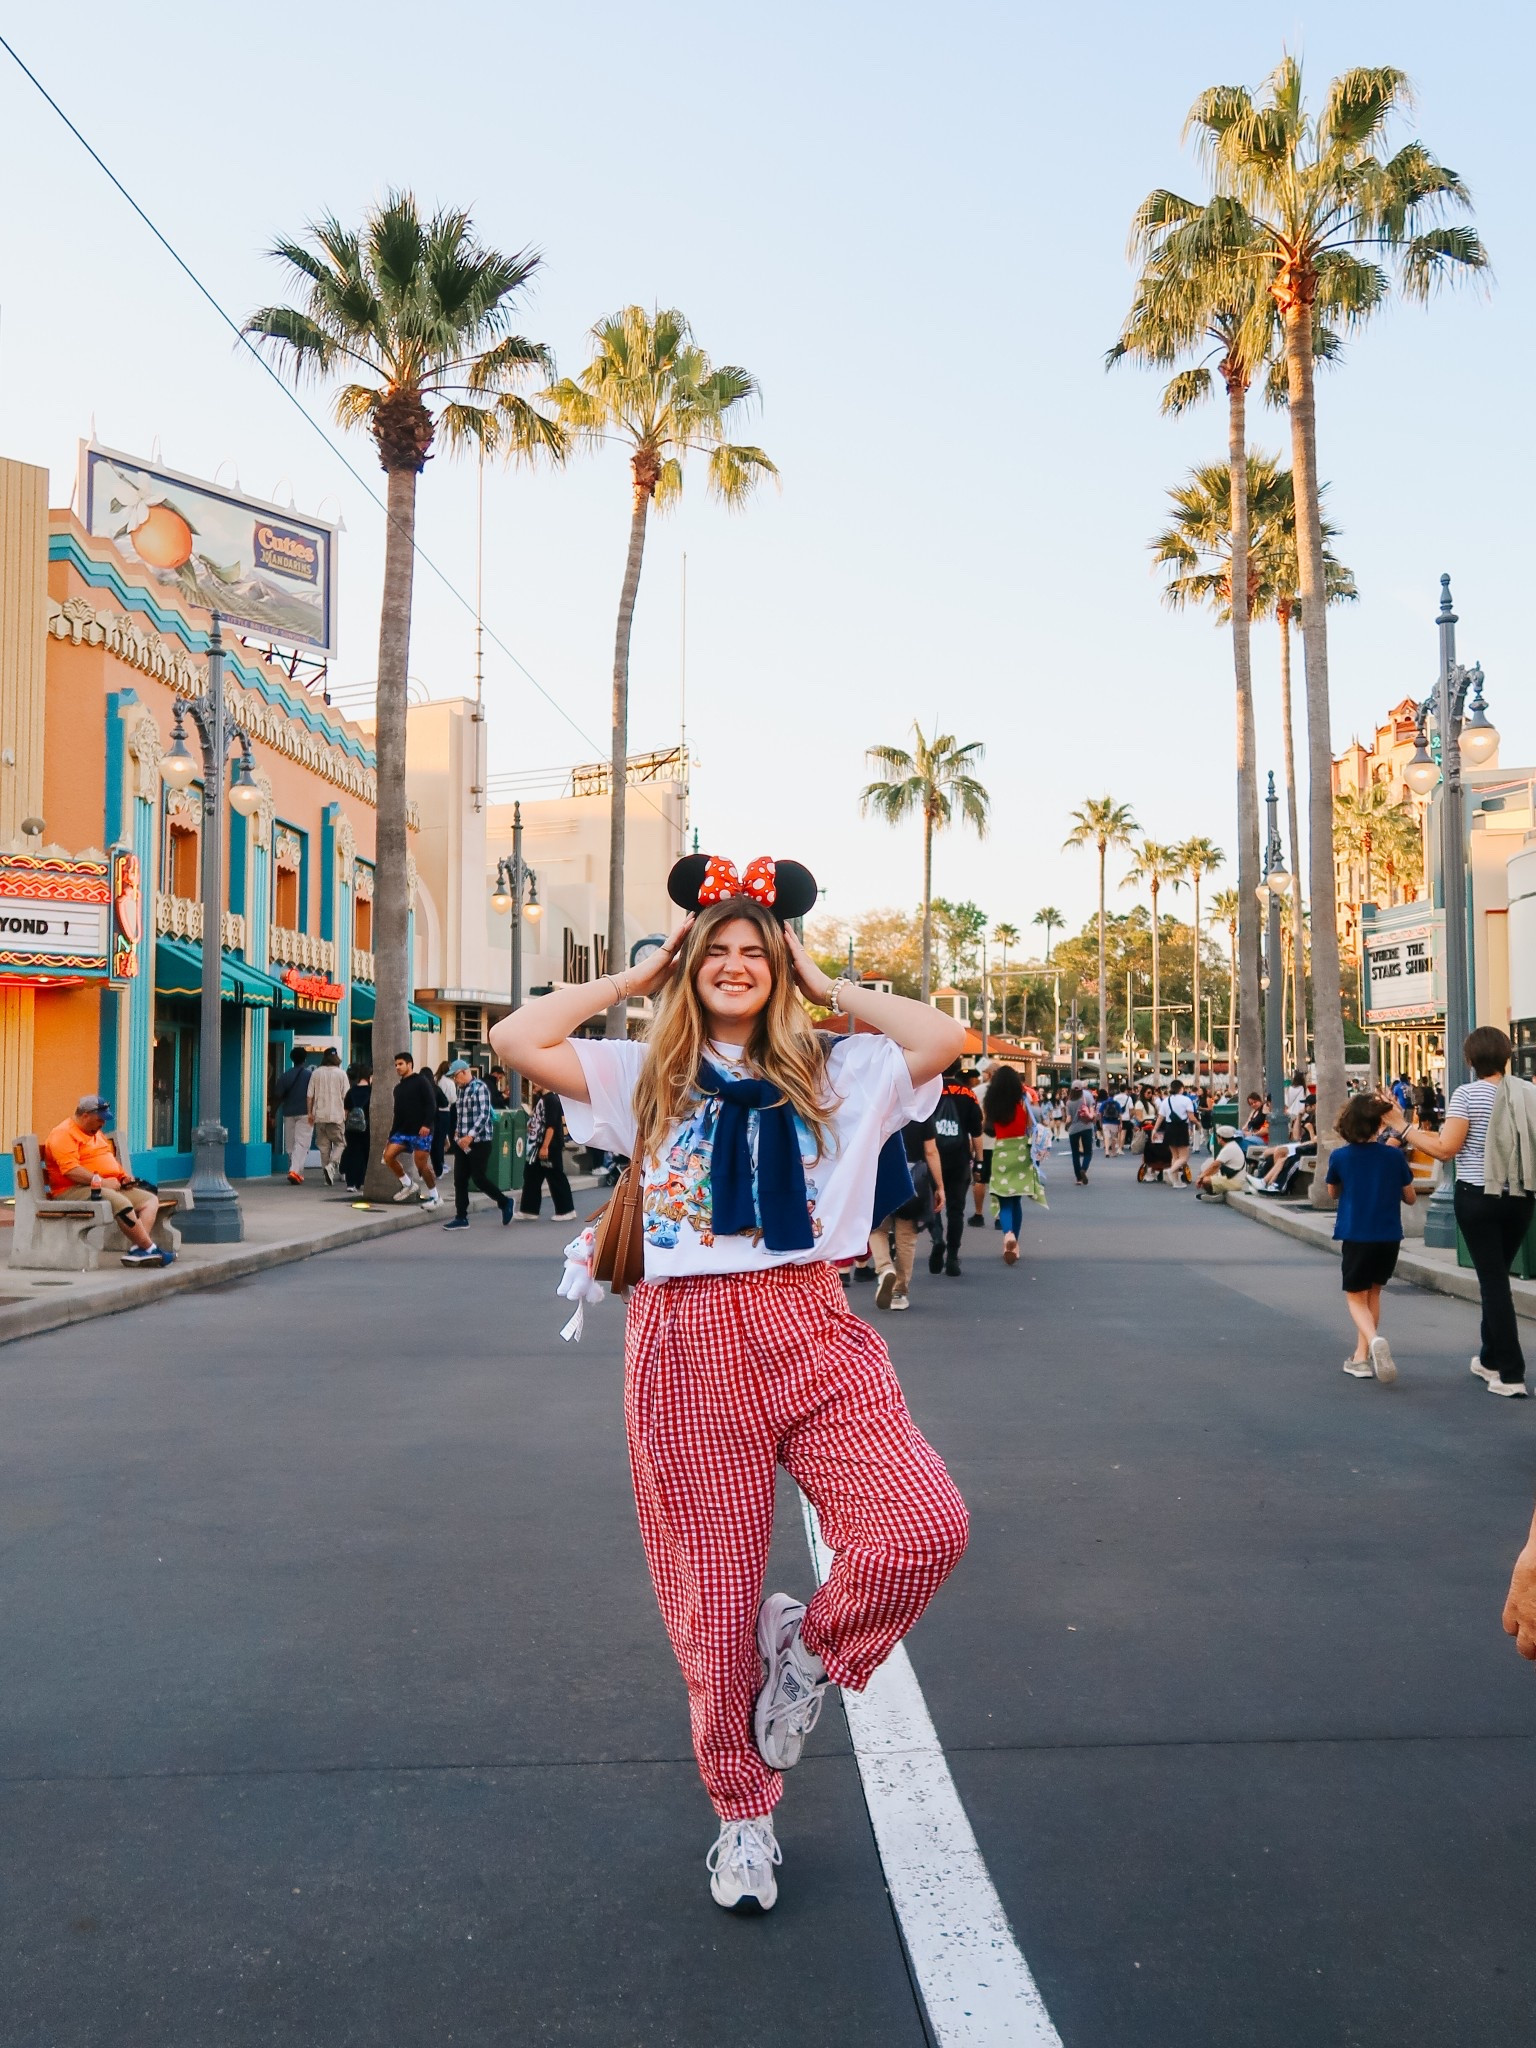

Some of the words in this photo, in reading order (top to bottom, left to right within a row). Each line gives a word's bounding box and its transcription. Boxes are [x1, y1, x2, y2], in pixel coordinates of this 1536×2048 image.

[258, 527, 315, 563] Cuties
[1406, 942, 1425, 957] THE
[1371, 963, 1401, 980] STARS
